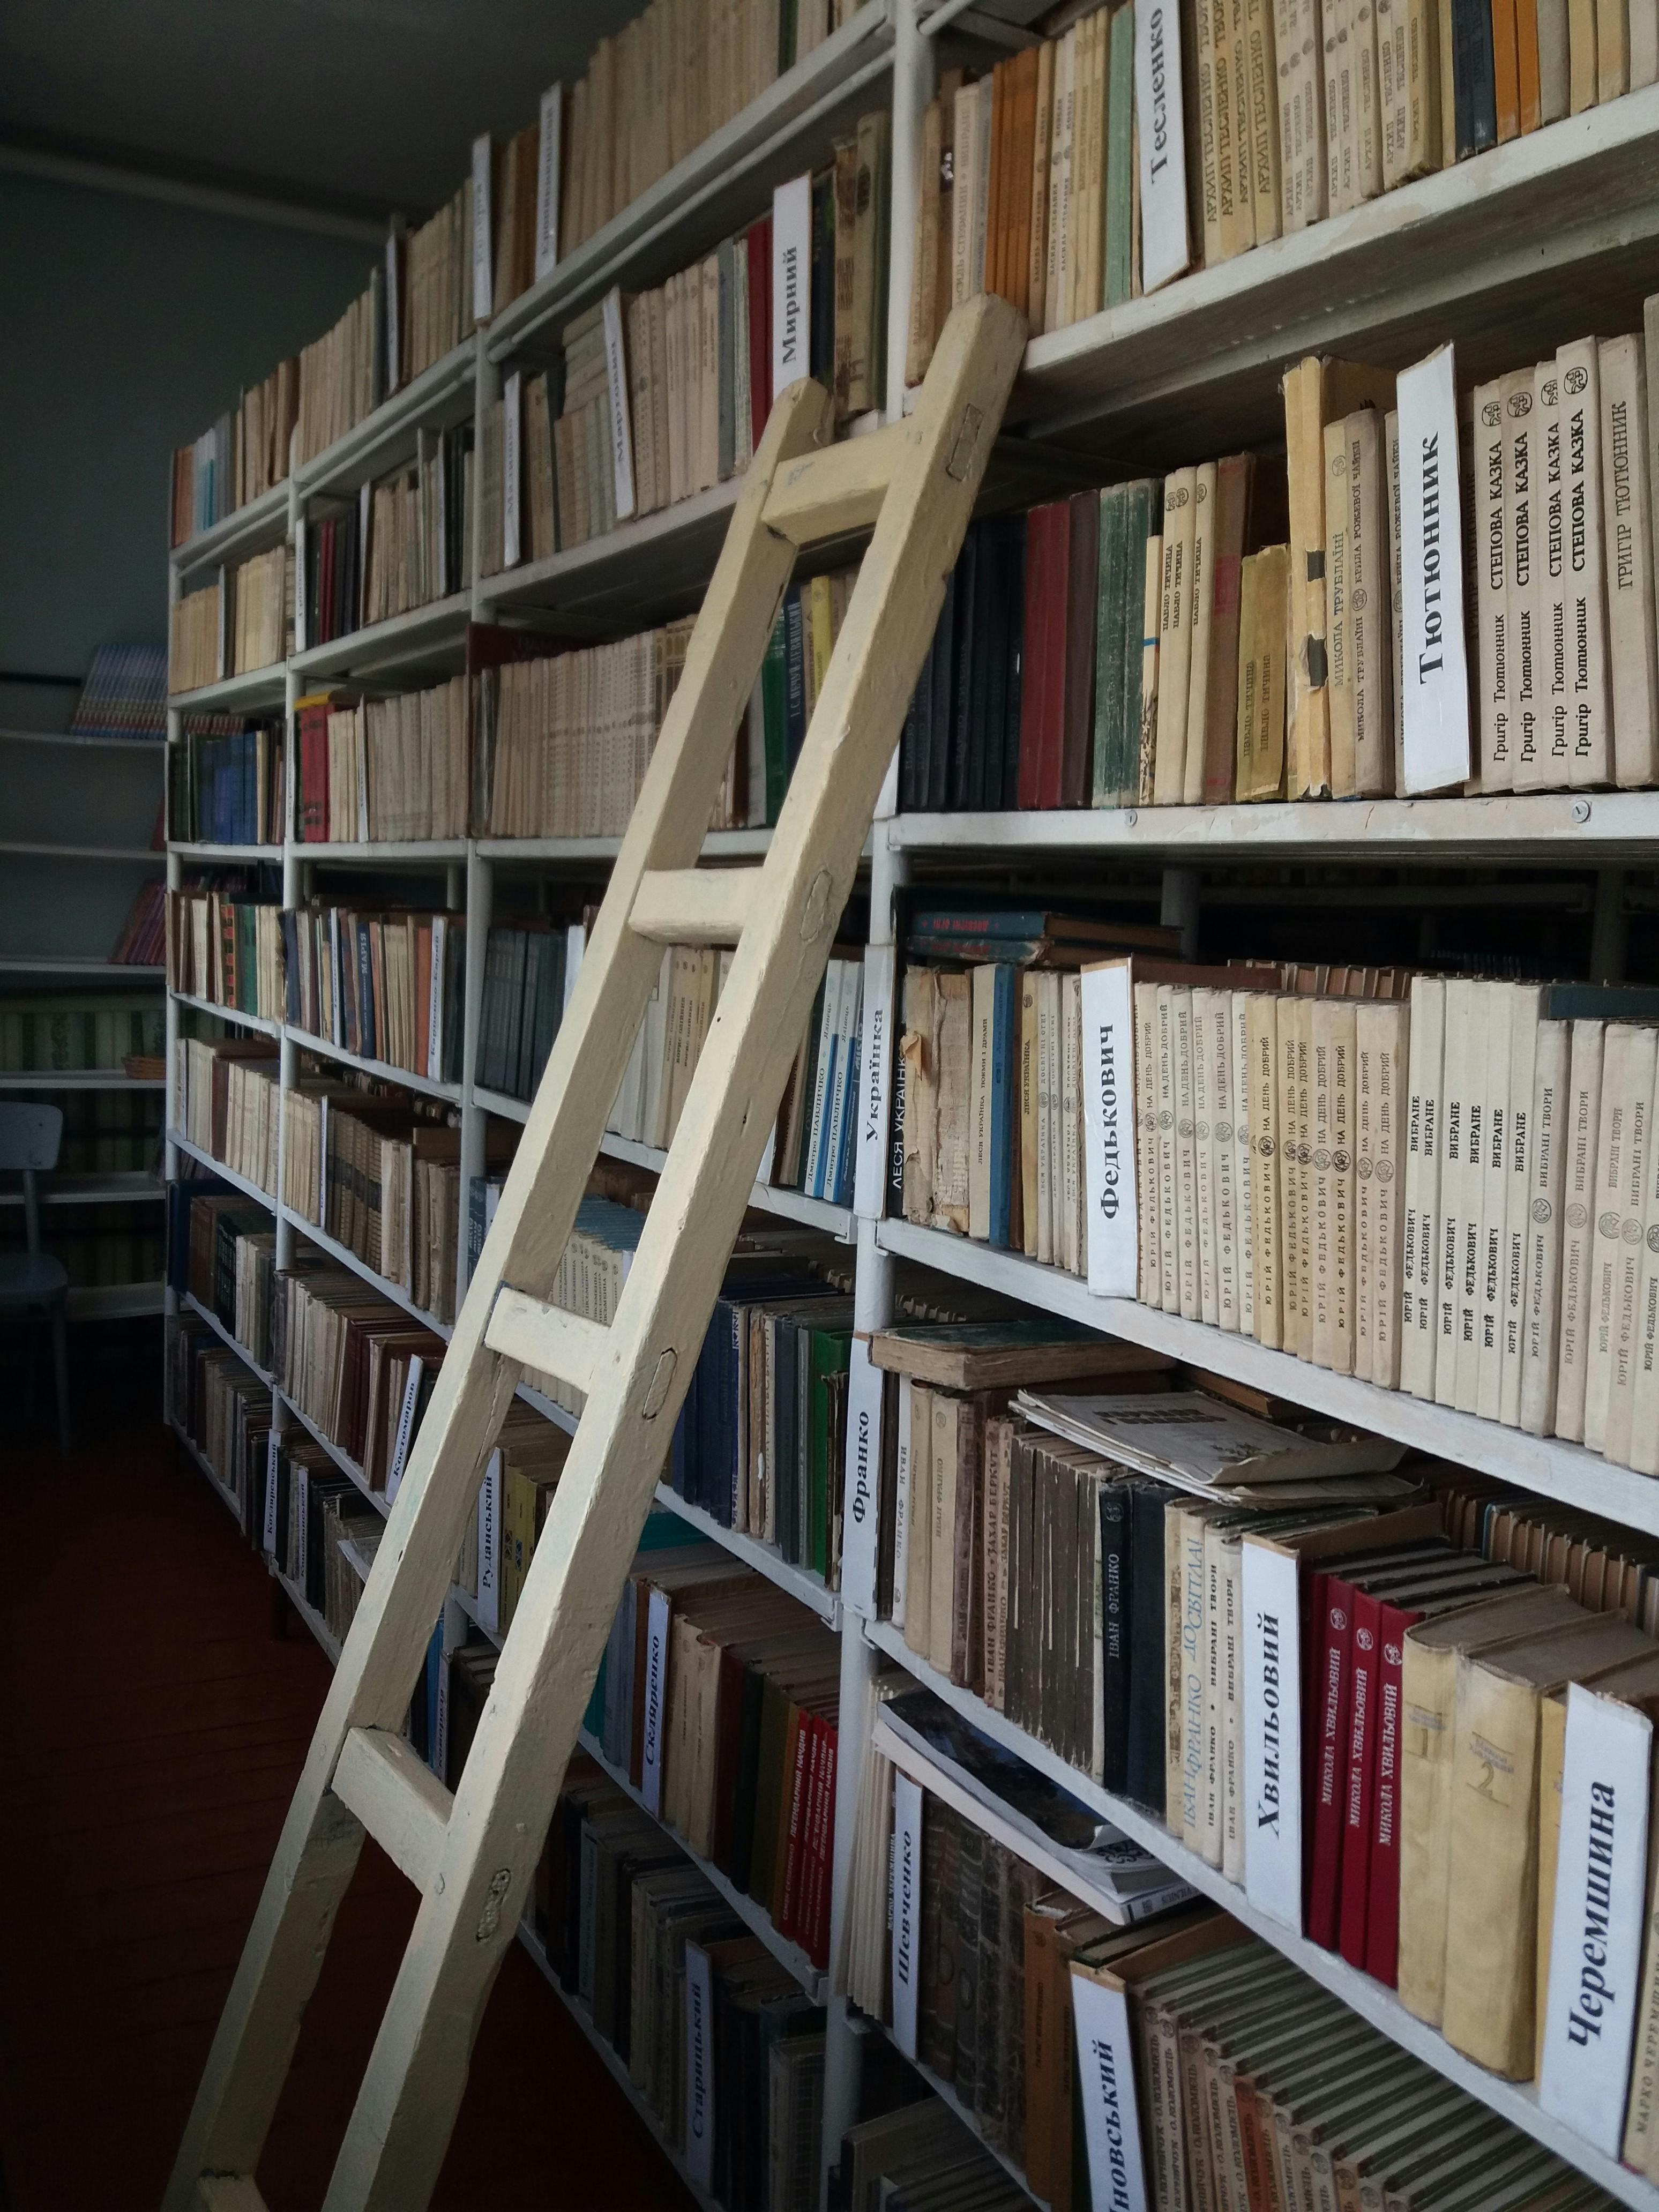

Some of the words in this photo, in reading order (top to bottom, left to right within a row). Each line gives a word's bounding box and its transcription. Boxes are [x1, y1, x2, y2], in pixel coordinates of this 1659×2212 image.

[1150, 8, 1168, 185] Тесленко
[1215, 57, 1230, 154] ТЕСЛЕНКО
[1235, 40, 1246, 141] ТЕСЛЕНКО
[1250, 31, 1266, 130] ТЕСЛЕНКО
[1200, 63, 1214, 160] ТЕСЛЕНКО
[1205, 161, 1217, 222] АРХИП
[1220, 154, 1232, 215] АРХИП
[1238, 141, 1247, 203] АРХИП
[1256, 130, 1271, 193] АРХИП
[782, 246, 800, 364] Мирний
[1352, 439, 1362, 481] ЧАЙКИ
[1489, 440, 1502, 499] КАЗКА
[1515, 432, 1528, 493] КАЗКА
[1547, 422, 1560, 481] КАЗКА
[1571, 408, 1585, 473] КАЗКА
[1612, 400, 1631, 516] ТЮТЮННИК
[1352, 484, 1362, 540] РОЖЕВОЇ
[1548, 490, 1562, 578] СТЕПОВА
[1571, 480, 1586, 572] СТЕПОВА
[1163, 544, 1174, 589] ТИЧИНА
[1175, 541, 1183, 586] ТИЧИНА
[1332, 532, 1344, 615] ТРУБЛАЇНІ
[1418, 431, 1444, 685] Тютюнник
[1490, 506, 1504, 591] СТЕПОВА
[1516, 500, 1530, 587] СТЕПОВА
[1617, 523, 1633, 589] ГРИГІР
[1162, 594, 1170, 631] ПАВЛО
[1333, 621, 1344, 686] МИКОЛА
[1355, 616, 1364, 683] ТРУБЛАЇНІ
[1493, 614, 1506, 703] Тютюнник
[1520, 610, 1533, 701] Тютюнник
[1551, 602, 1564, 695] Тютюнник
[1574, 597, 1588, 693] Тютюнник
[1246, 661, 1254, 709] ТИЧИНА
[1261, 654, 1272, 701] ТИЧИНА
[1260, 708, 1271, 750] ПАВЛО
[1357, 689, 1365, 742] МИКОЛА
[1493, 712, 1509, 762] Григір
[1521, 712, 1536, 763] Григір
[1552, 706, 1568, 757] Григір
[1575, 704, 1591, 757] Григір
[360, 933, 368, 974] МАРІЯ
[1160, 1004, 1168, 1050] ДОБРИЙ
[1215, 1012, 1225, 1059] ДОБРИЙ
[866, 1008, 883, 1144] Українка
[1022, 1040, 1031, 1087] УКРАЇНКА
[1162, 1085, 1169, 1098] НА
[1217, 1062, 1227, 1093] ДЕНЬ
[1297, 1042, 1307, 1082] ДОБРИЙ
[806, 1141, 818, 1182] Дмитро
[812, 1068, 825, 1136] ПАВЛИЧКО
[831, 1072, 844, 1141] ПАВЛИЧКО
[1099, 1025, 1122, 1219] Федькович
[1219, 1095, 1226, 1109] НА
[1299, 1089, 1307, 1117] ДЕНЬ
[1300, 1124, 1307, 1138] НА
[1449, 1102, 1460, 1159] ВИБРАНЕ
[1542, 1088, 1553, 1128] ТВОРИ
[1578, 1092, 1588, 1132] ТВОРИ
[1634, 1102, 1645, 1144] ТВОРИ
[826, 1146, 838, 1187] Дмитро
[893, 1142, 903, 1189] ЛЕСЯ
[1492, 1109, 1503, 1168] ВИБРАНЕ
[1540, 1133, 1550, 1188] ВИБРАНІ
[1575, 1137, 1586, 1191] ВИБРАНІ
[1163, 1141, 1172, 1238] ФЕДЬКОВИЧ
[1221, 1154, 1232, 1254] ФЕДЬКОВИЧ
[1631, 1150, 1641, 1206] ВИБРАНІ
[1301, 1171, 1309, 1268] ФЕДЬКОВИЧ
[1445, 1218, 1456, 1290] ФЕДЬКОВИЧ
[1486, 1228, 1498, 1302] ФЕДЬКОВИЧ
[1534, 1235, 1544, 1316] ФЕДЬКОВИЧ
[1567, 1240, 1580, 1321] ФЕДЬКОВИЧ
[1224, 1267, 1232, 1308] ЮРІЙ
[1620, 1258, 1634, 1341] ФЕДЬКОВИЧ
[1443, 1302, 1452, 1334] ЮРІЙ
[1484, 1314, 1494, 1347] ЮРІЙ
[1531, 1322, 1540, 1357] ЮРІЙ
[1565, 1328, 1575, 1364] ЮРІЙ
[1617, 1348, 1628, 1385] ЮРІЙ
[1644, 1343, 1654, 1371] ЮРІЙ
[393, 1383, 414, 1476] Костомаров
[853, 1411, 870, 1523] Франко
[936, 1458, 944, 1504] ФРАНКО
[988, 1450, 998, 1507] БЕРКУТ
[482, 1476, 493, 1588] Руданський
[988, 1511, 997, 1556] ЗАХАР
[987, 1572, 996, 1632] ФРАНКО
[1108, 1553, 1119, 1613] ФРАНКО
[987, 1638, 995, 1673] ІВАН
[1109, 1622, 1119, 1659] ІВАН
[646, 1636, 659, 1766] Скляренко
[1325, 1647, 1341, 1740] ХВИЛЬОВИЙ
[1352, 1668, 1368, 1762] ХВИЛЬОВИЙ
[795, 1730, 806, 1768] НАЧДИВ
[1187, 1674, 1202, 1775] ФРАНКО
[1257, 1612, 1279, 1840] Хвильовий
[1380, 1683, 1398, 1778] ХВИЛЬОВИЙ
[790, 1771, 802, 1837] ЛЕГЕНДАРНИЙ
[1183, 1769, 1195, 1828] ІВАН
[1321, 1745, 1335, 1806] МИКОЛА
[1349, 1768, 1363, 1828] МИКОЛА
[1378, 1783, 1393, 1846] МИКОЛА
[898, 1830, 911, 1985] Шевченко
[1566, 1782, 1615, 2047] Черемшина
[692, 1983, 706, 2139] Старицький
[1636, 2075, 1653, 2135] МАРКО
